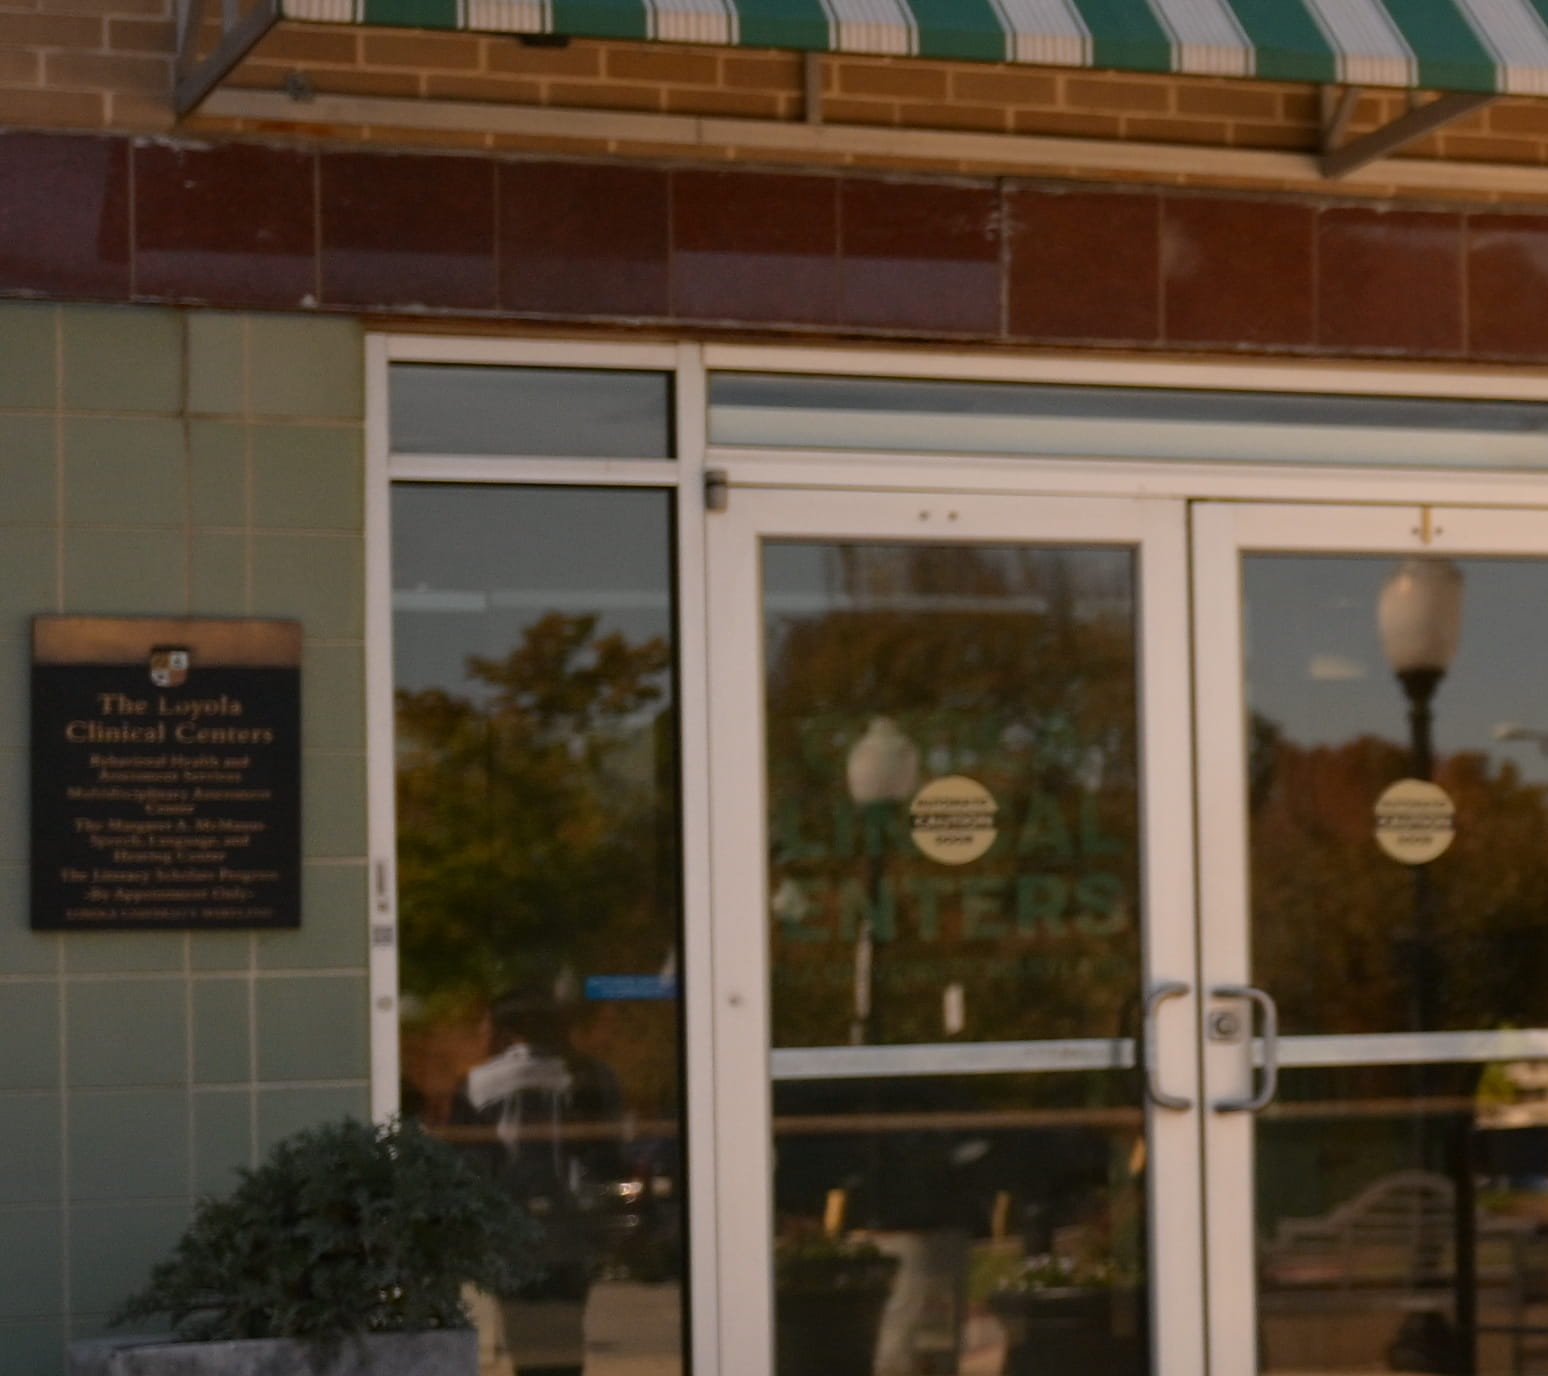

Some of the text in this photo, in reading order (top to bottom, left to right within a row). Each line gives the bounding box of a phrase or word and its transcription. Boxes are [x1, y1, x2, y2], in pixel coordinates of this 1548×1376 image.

[98, 692, 243, 720] The Loyola
[65, 720, 274, 745] Clinical Centers
[778, 872, 1127, 944] ENTERS
